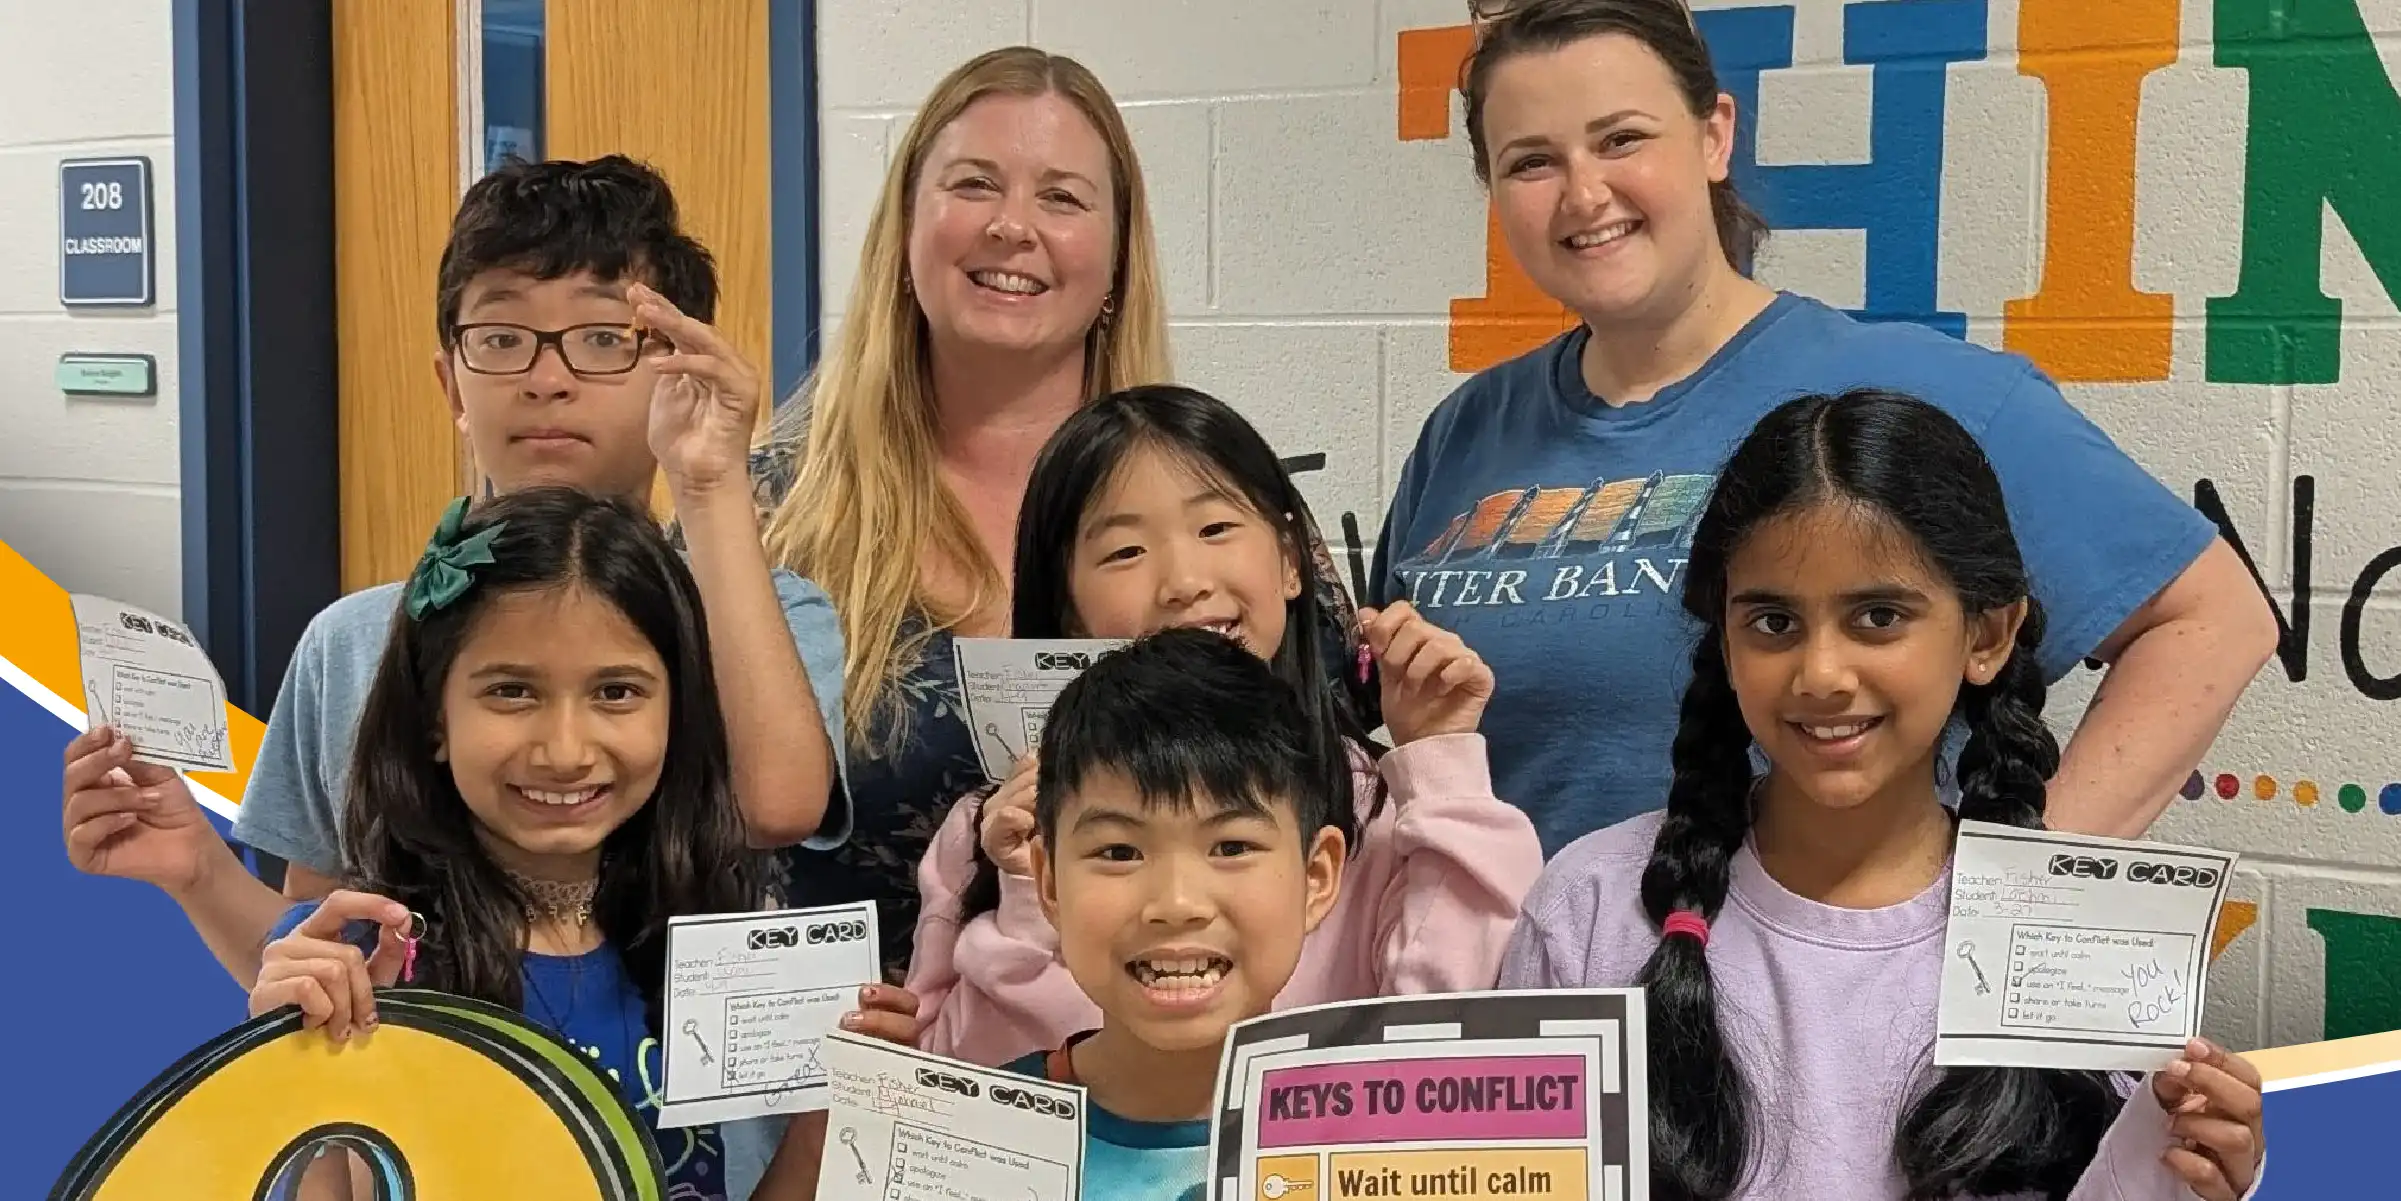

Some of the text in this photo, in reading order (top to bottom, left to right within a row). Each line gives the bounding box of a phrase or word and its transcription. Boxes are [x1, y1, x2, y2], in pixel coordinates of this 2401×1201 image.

[81, 182, 122, 210] 208
[66, 237, 142, 254] CLASSROOM
[1035, 652, 1090, 670] KEY
[2048, 854, 2221, 888] KEY CARD
[747, 920, 867, 950] KEY CARD
[915, 1067, 1076, 1120] KEY CARD
[1268, 1075, 1579, 1121] KEYS TO CONFLICT
[1338, 1164, 1551, 1197] Wait until calm
